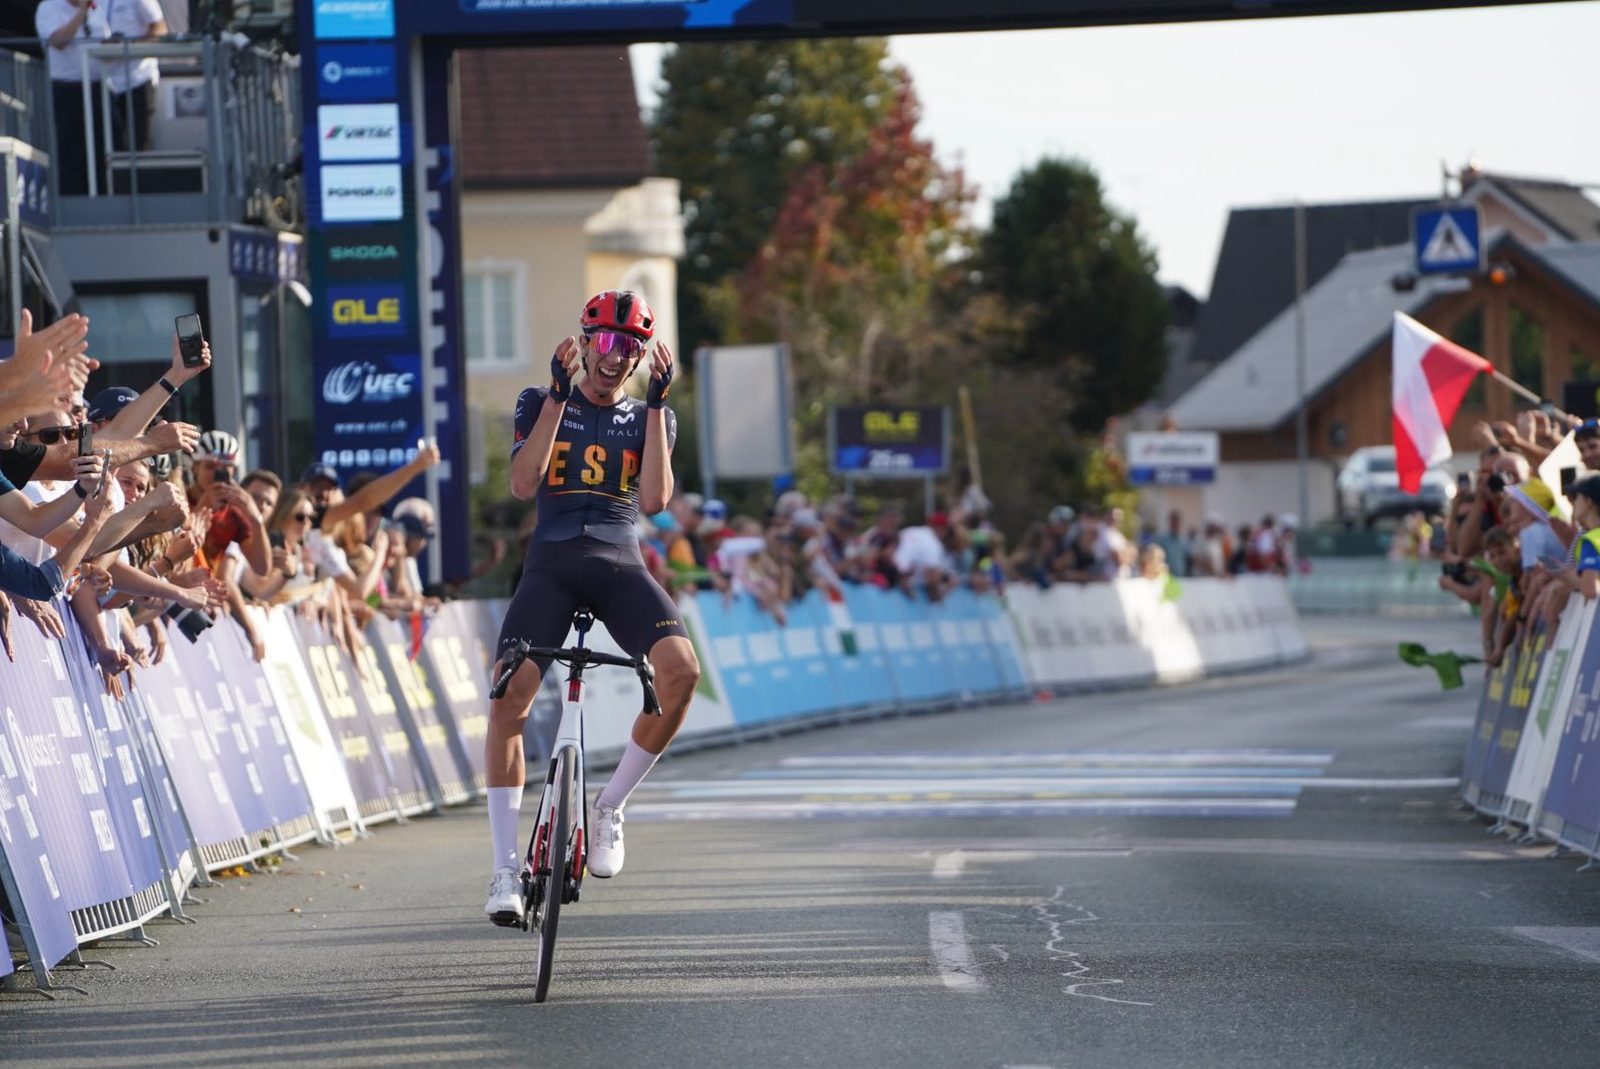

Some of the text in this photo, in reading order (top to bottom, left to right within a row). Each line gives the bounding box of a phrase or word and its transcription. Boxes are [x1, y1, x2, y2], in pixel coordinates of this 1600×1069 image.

[364, 373, 414, 393] UEC
[563, 419, 585, 431] GOBIK
[548, 441, 638, 491] ESP
